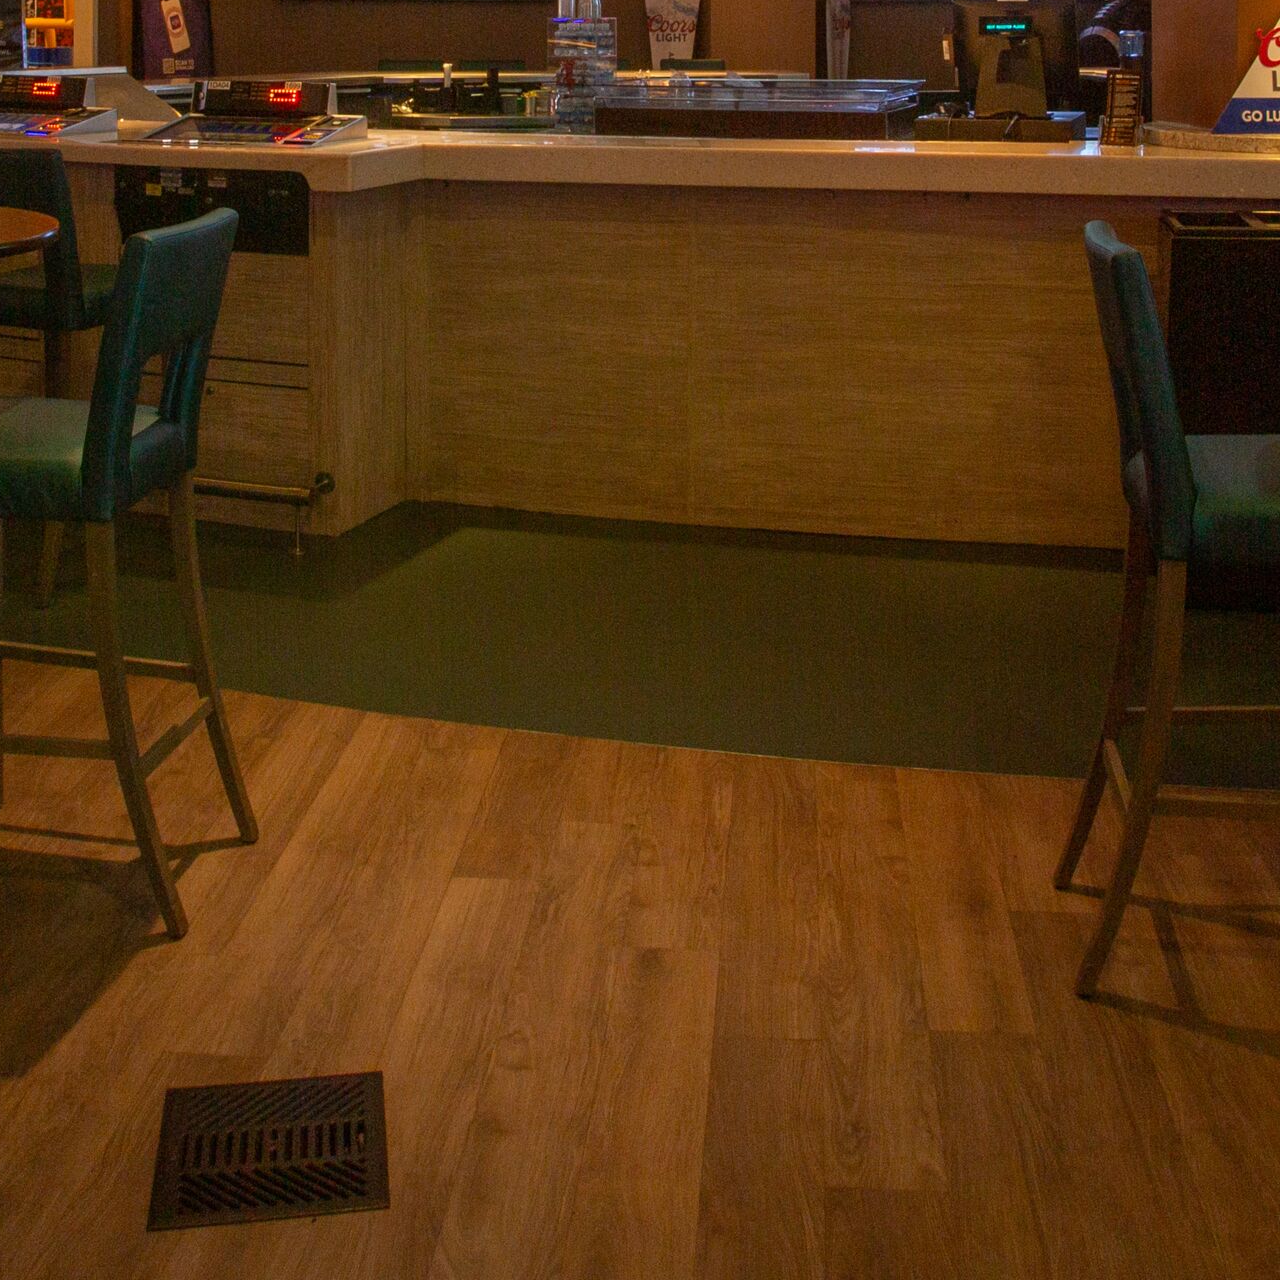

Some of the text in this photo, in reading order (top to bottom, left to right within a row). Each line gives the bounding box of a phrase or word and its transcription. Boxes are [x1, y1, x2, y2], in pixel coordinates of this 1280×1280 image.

[647, 14, 696, 33] Coors
[656, 33, 687, 42] LIGHT
[1242, 110, 1263, 122] GO
